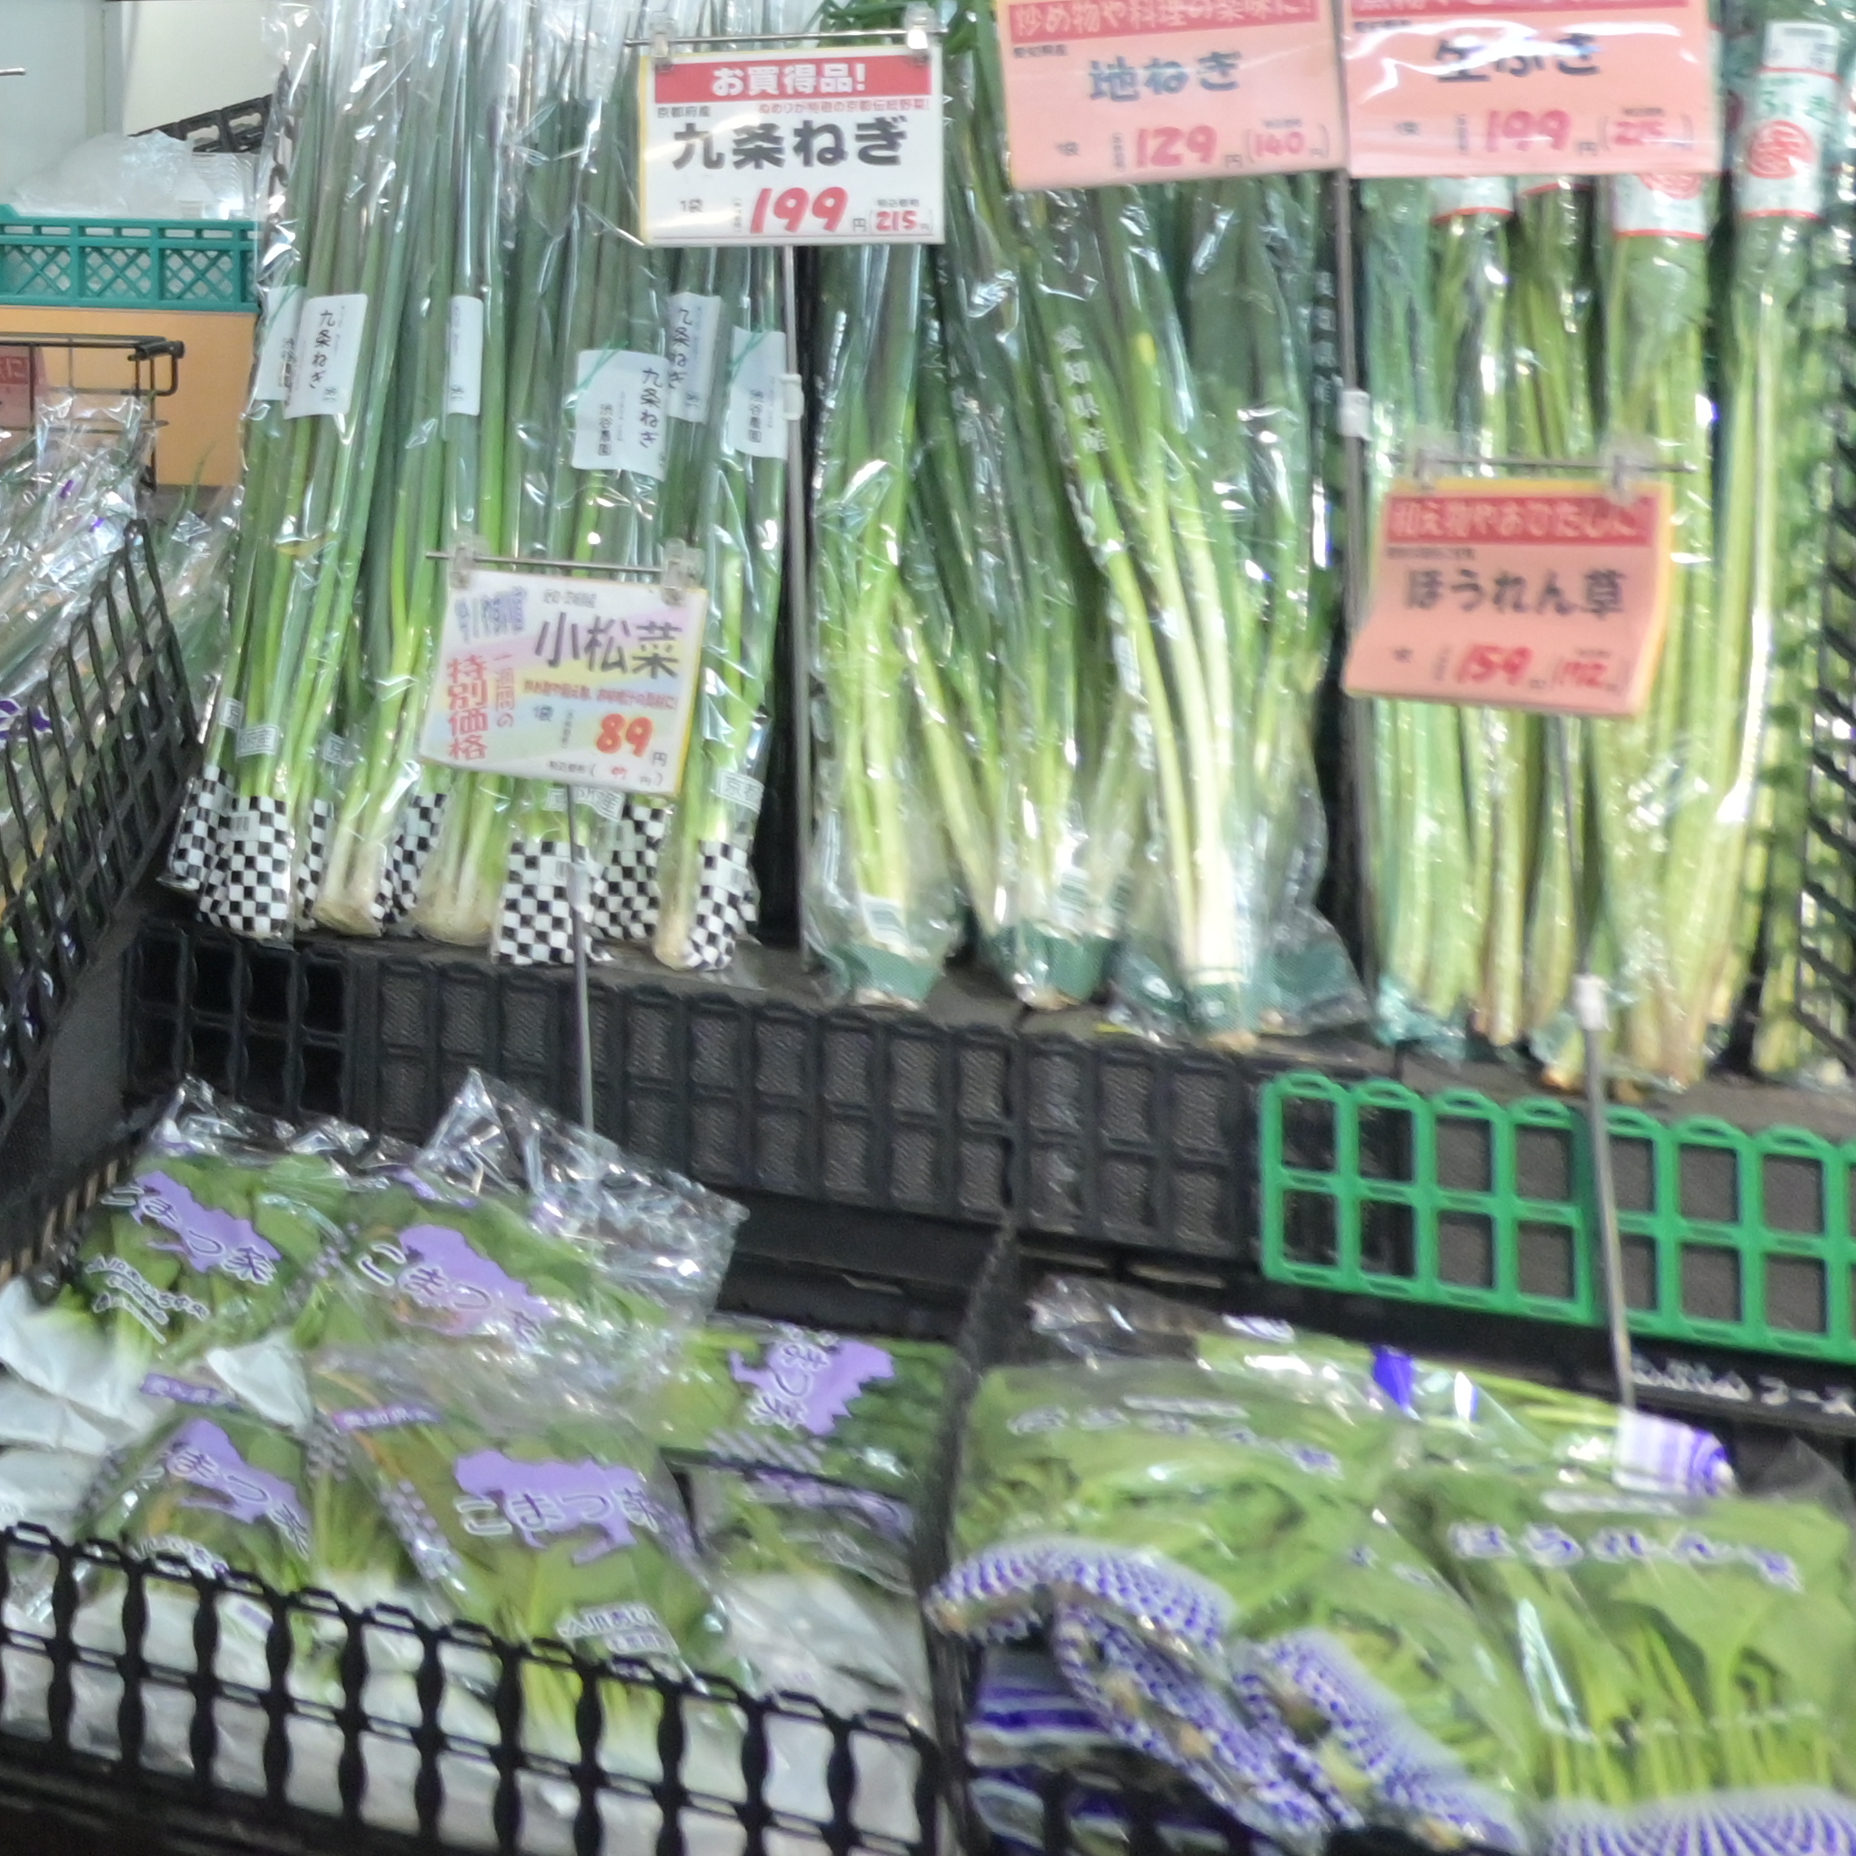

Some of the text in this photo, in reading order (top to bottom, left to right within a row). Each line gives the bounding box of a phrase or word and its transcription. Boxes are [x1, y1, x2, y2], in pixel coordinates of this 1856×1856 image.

[712, 63, 867, 97] お買得品!
[1089, 51, 1243, 102] 地ねぎ
[657, 106, 711, 118] 京都府産
[1487, 109, 1572, 153] 199
[672, 115, 908, 171] 九条ねぎ
[1137, 124, 1219, 169] 129
[750, 186, 849, 234] 199
[876, 210, 918, 232] 215
[309, 309, 337, 391] 九条ねぎ
[1405, 568, 1626, 621] ほうれん草
[535, 611, 683, 679] 小松菜
[447, 653, 489, 762] 特別価格
[596, 713, 654, 757] 89
[453, 1482, 662, 1539] こまつ菜
